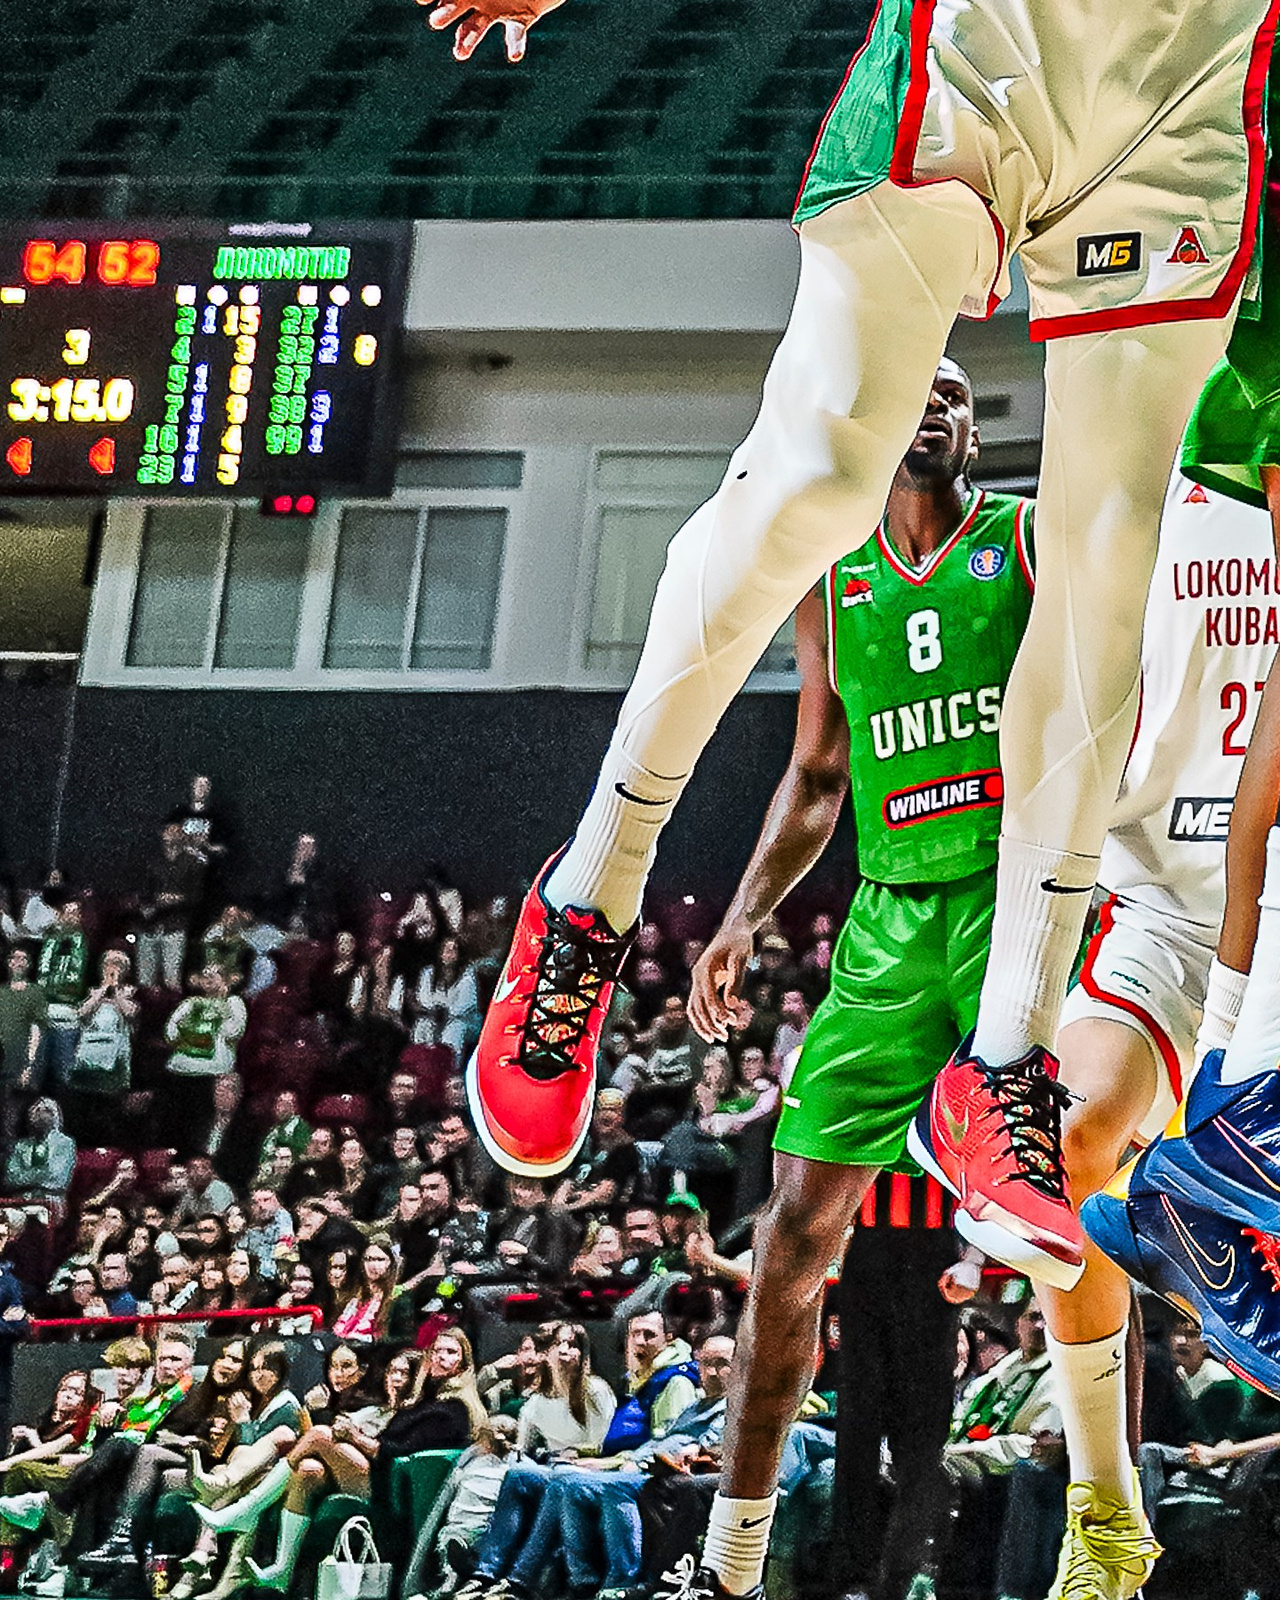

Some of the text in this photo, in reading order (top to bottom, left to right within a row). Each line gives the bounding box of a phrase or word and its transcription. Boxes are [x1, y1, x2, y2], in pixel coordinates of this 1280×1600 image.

[25, 241, 160, 285] 54 52
[175, 305, 261, 336] 2 1 15
[324, 305, 339, 334] 1
[62, 328, 91, 365] 3
[171, 334, 257, 365] 4 3
[318, 334, 340, 364] 2
[166, 364, 189, 394] 5
[193, 363, 208, 393] 1
[7, 377, 134, 422] 3:15.0
[164, 394, 185, 423] 7
[189, 394, 204, 423] 1
[185, 424, 200, 453] 1
[221, 424, 243, 454] 4
[308, 424, 323, 453] 1
[180, 453, 196, 483] 1
[216, 453, 240, 485] 5
[906, 609, 943, 673] 8
[870, 686, 999, 760] UNICS
[889, 779, 980, 822] WINLINE
